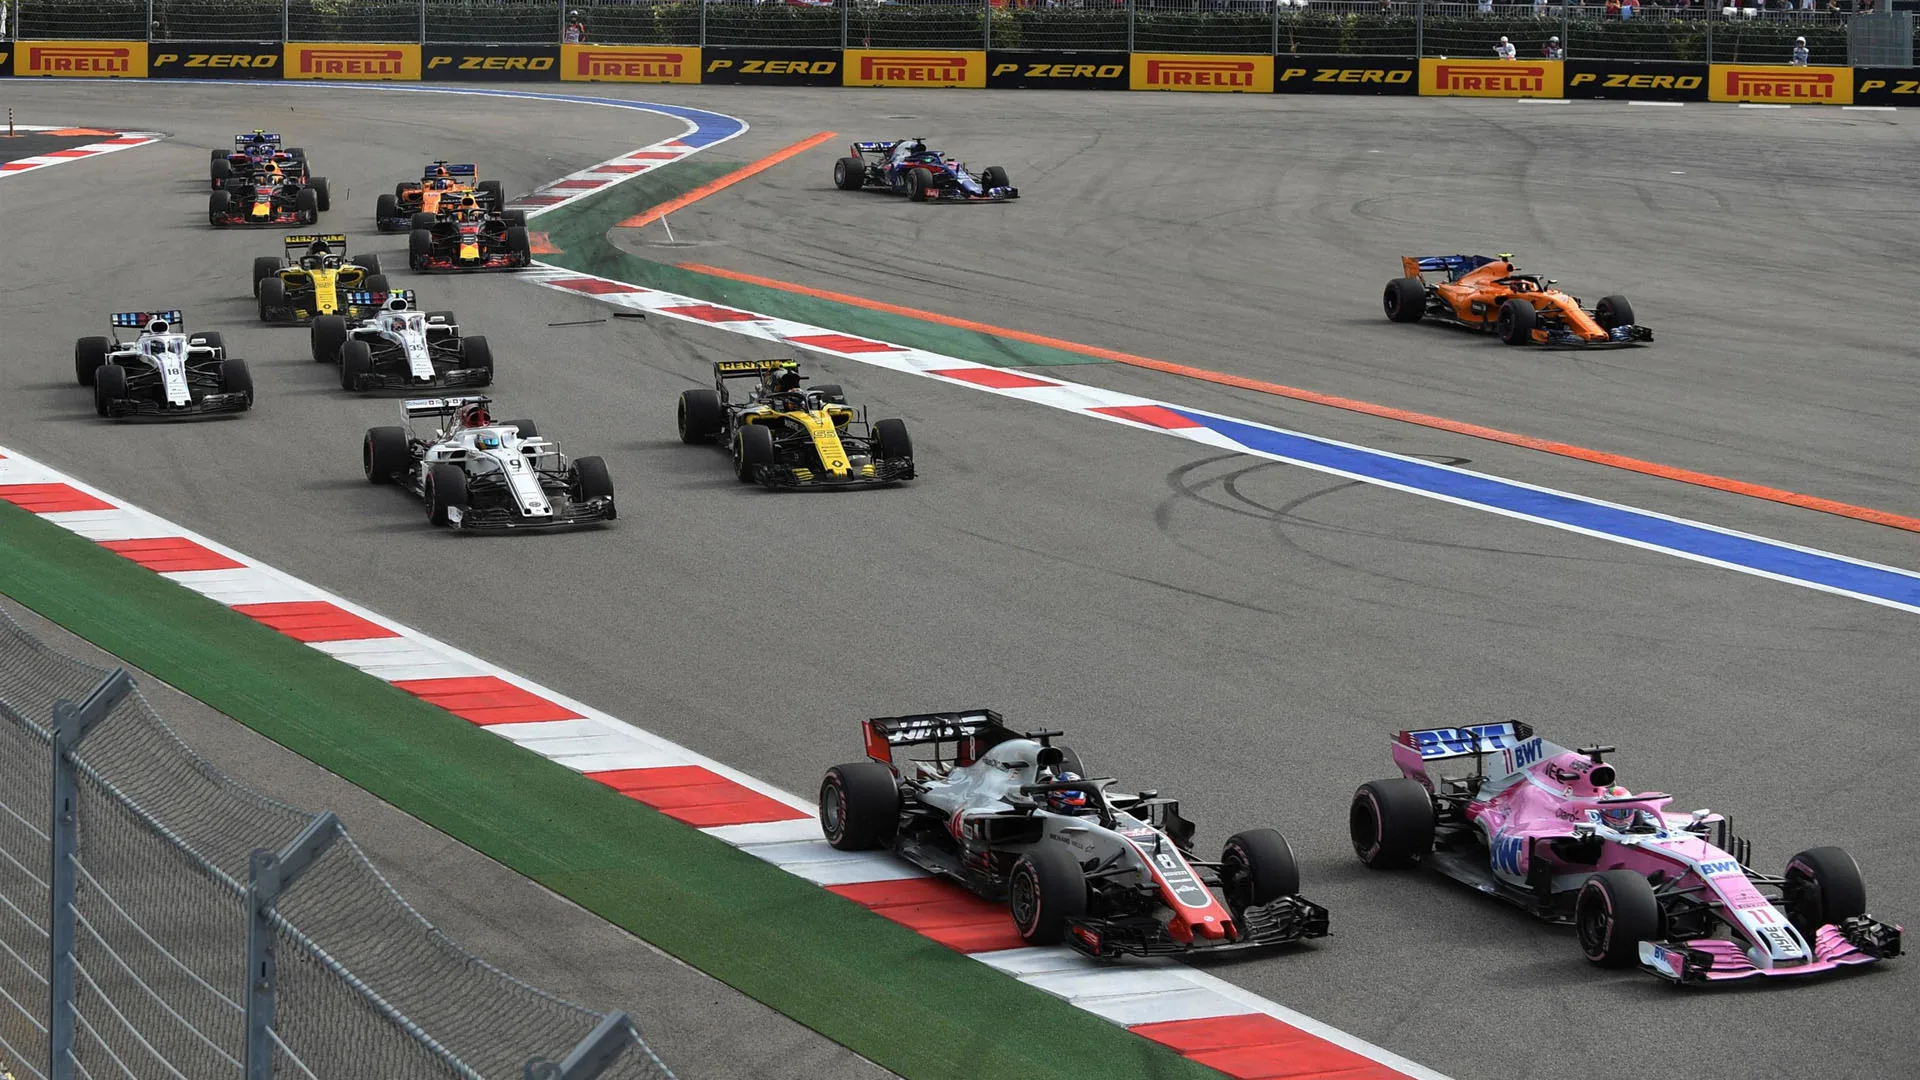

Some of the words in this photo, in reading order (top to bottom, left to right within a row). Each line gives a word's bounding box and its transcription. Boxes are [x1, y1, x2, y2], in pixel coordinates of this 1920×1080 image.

[29, 47, 130, 72] PIRELLI
[155, 54, 177, 67] P
[184, 54, 278, 68] ZERO
[300, 50, 403, 75] PIRELLI
[430, 57, 452, 69] P
[459, 57, 554, 70] ZERO
[577, 52, 684, 77] PIRELLI
[708, 60, 733, 73] P
[740, 61, 837, 74] ZERO
[860, 56, 967, 82] PIRELLI
[993, 63, 1018, 76] P
[1025, 64, 1124, 78] ZERO
[1147, 60, 1255, 87] PIRELLI
[1281, 69, 1306, 81] P
[1314, 69, 1412, 83] ZERO
[1436, 65, 1545, 91] PIRELLI
[1571, 73, 1597, 86] P
[1603, 74, 1702, 89] ZERO
[1726, 70, 1836, 98] PIRELLI
[1859, 80, 1886, 93] P
[814, 430, 836, 438] 55
[510, 459, 522, 469] 9
[969, 735, 976, 761] 8
[1413, 724, 1507, 757] BWT
[1503, 748, 1514, 774] 11
[1515, 737, 1543, 769] BWT
[1156, 854, 1177, 869] 8
[1701, 862, 1739, 875] BWT
[1748, 909, 1775, 924] 11
[1764, 926, 1796, 952] HYPE
